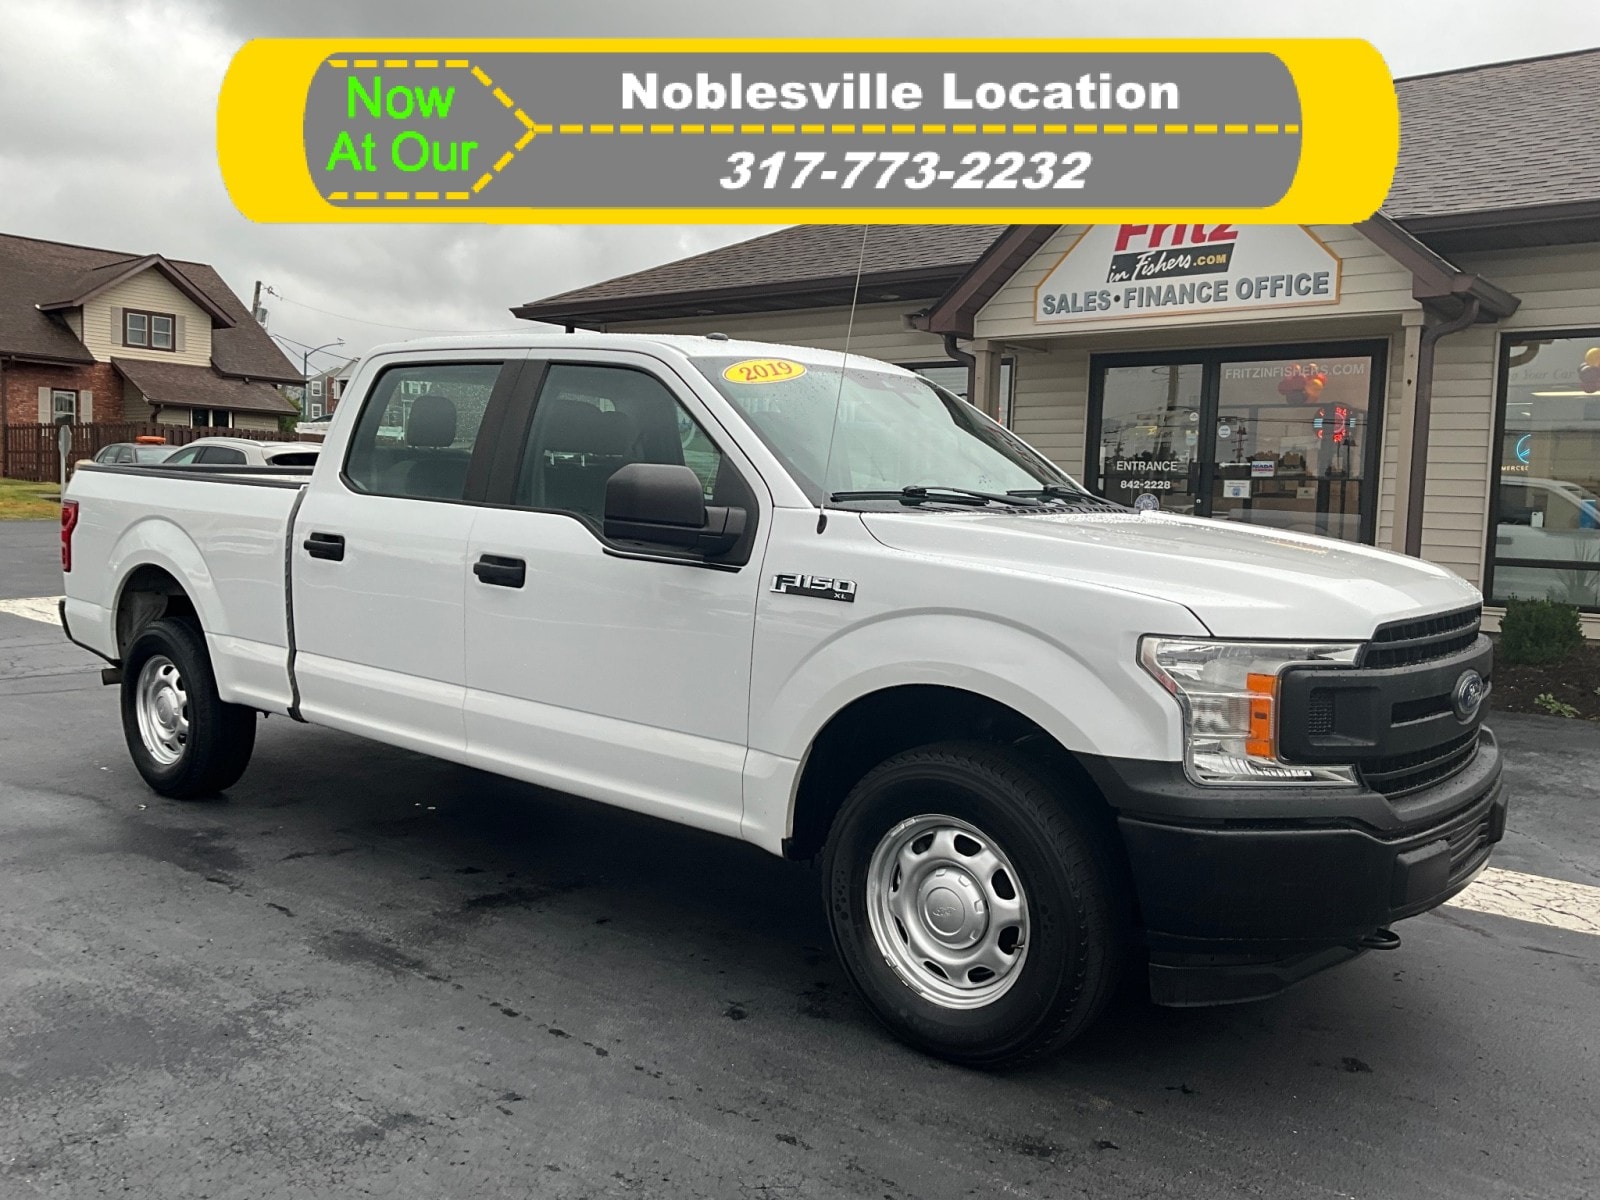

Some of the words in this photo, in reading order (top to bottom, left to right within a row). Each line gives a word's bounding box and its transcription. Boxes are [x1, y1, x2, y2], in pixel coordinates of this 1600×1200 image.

[1108, 265, 1130, 283] in
[1235, 271, 1330, 300] OFFICE
[738, 361, 793, 382] 2019
[1224, 363, 1365, 380] FRITZINFISHERS.COM
[1116, 460, 1179, 472] ENTRANCE
[1120, 480, 1171, 490] 842-2228
[834, 592, 847, 600] XL
